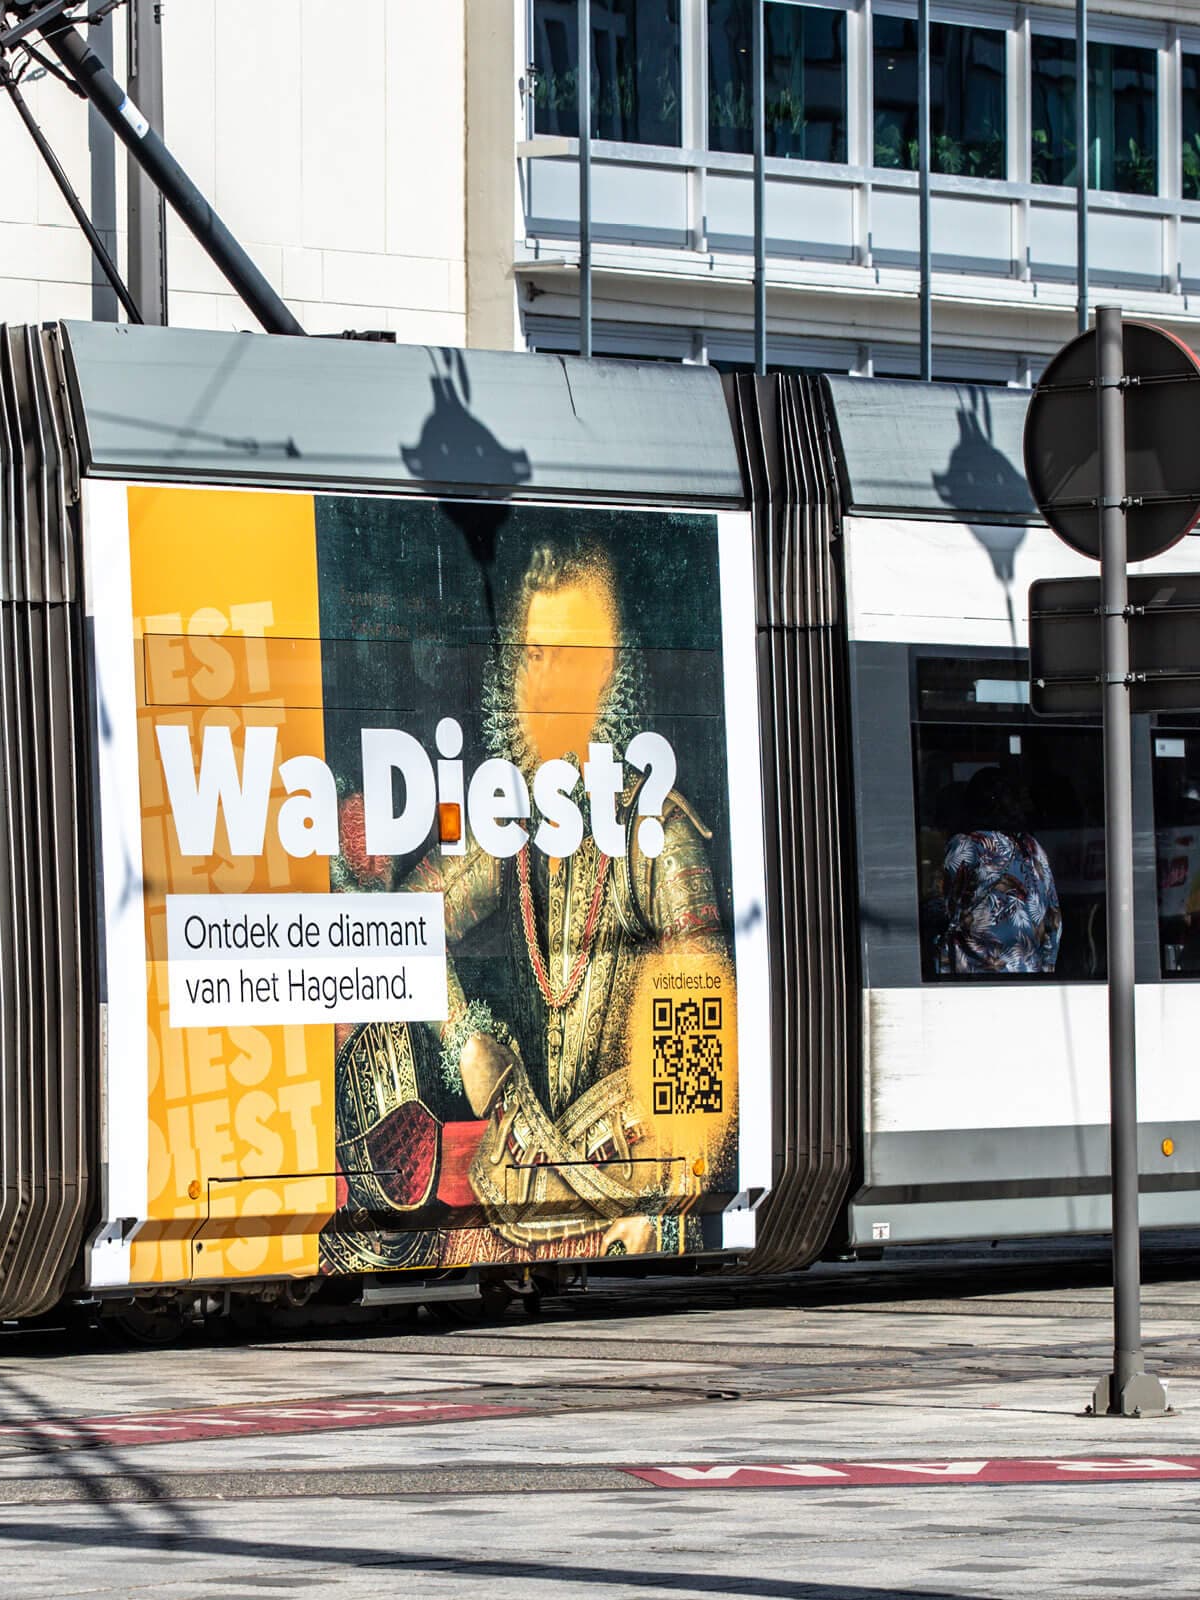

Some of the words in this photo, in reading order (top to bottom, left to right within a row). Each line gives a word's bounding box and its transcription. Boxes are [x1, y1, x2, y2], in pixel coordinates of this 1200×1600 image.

[155, 724, 340, 858] Wa
[360, 717, 677, 858] Diest?
[184, 914, 280, 949] Ontdek
[287, 914, 321, 948] de
[328, 913, 428, 947] diamant
[185, 977, 231, 1004] van
[240, 969, 280, 1002] het
[288, 966, 413, 1009] Hageland.
[653, 971, 722, 990] visitdiest.be
